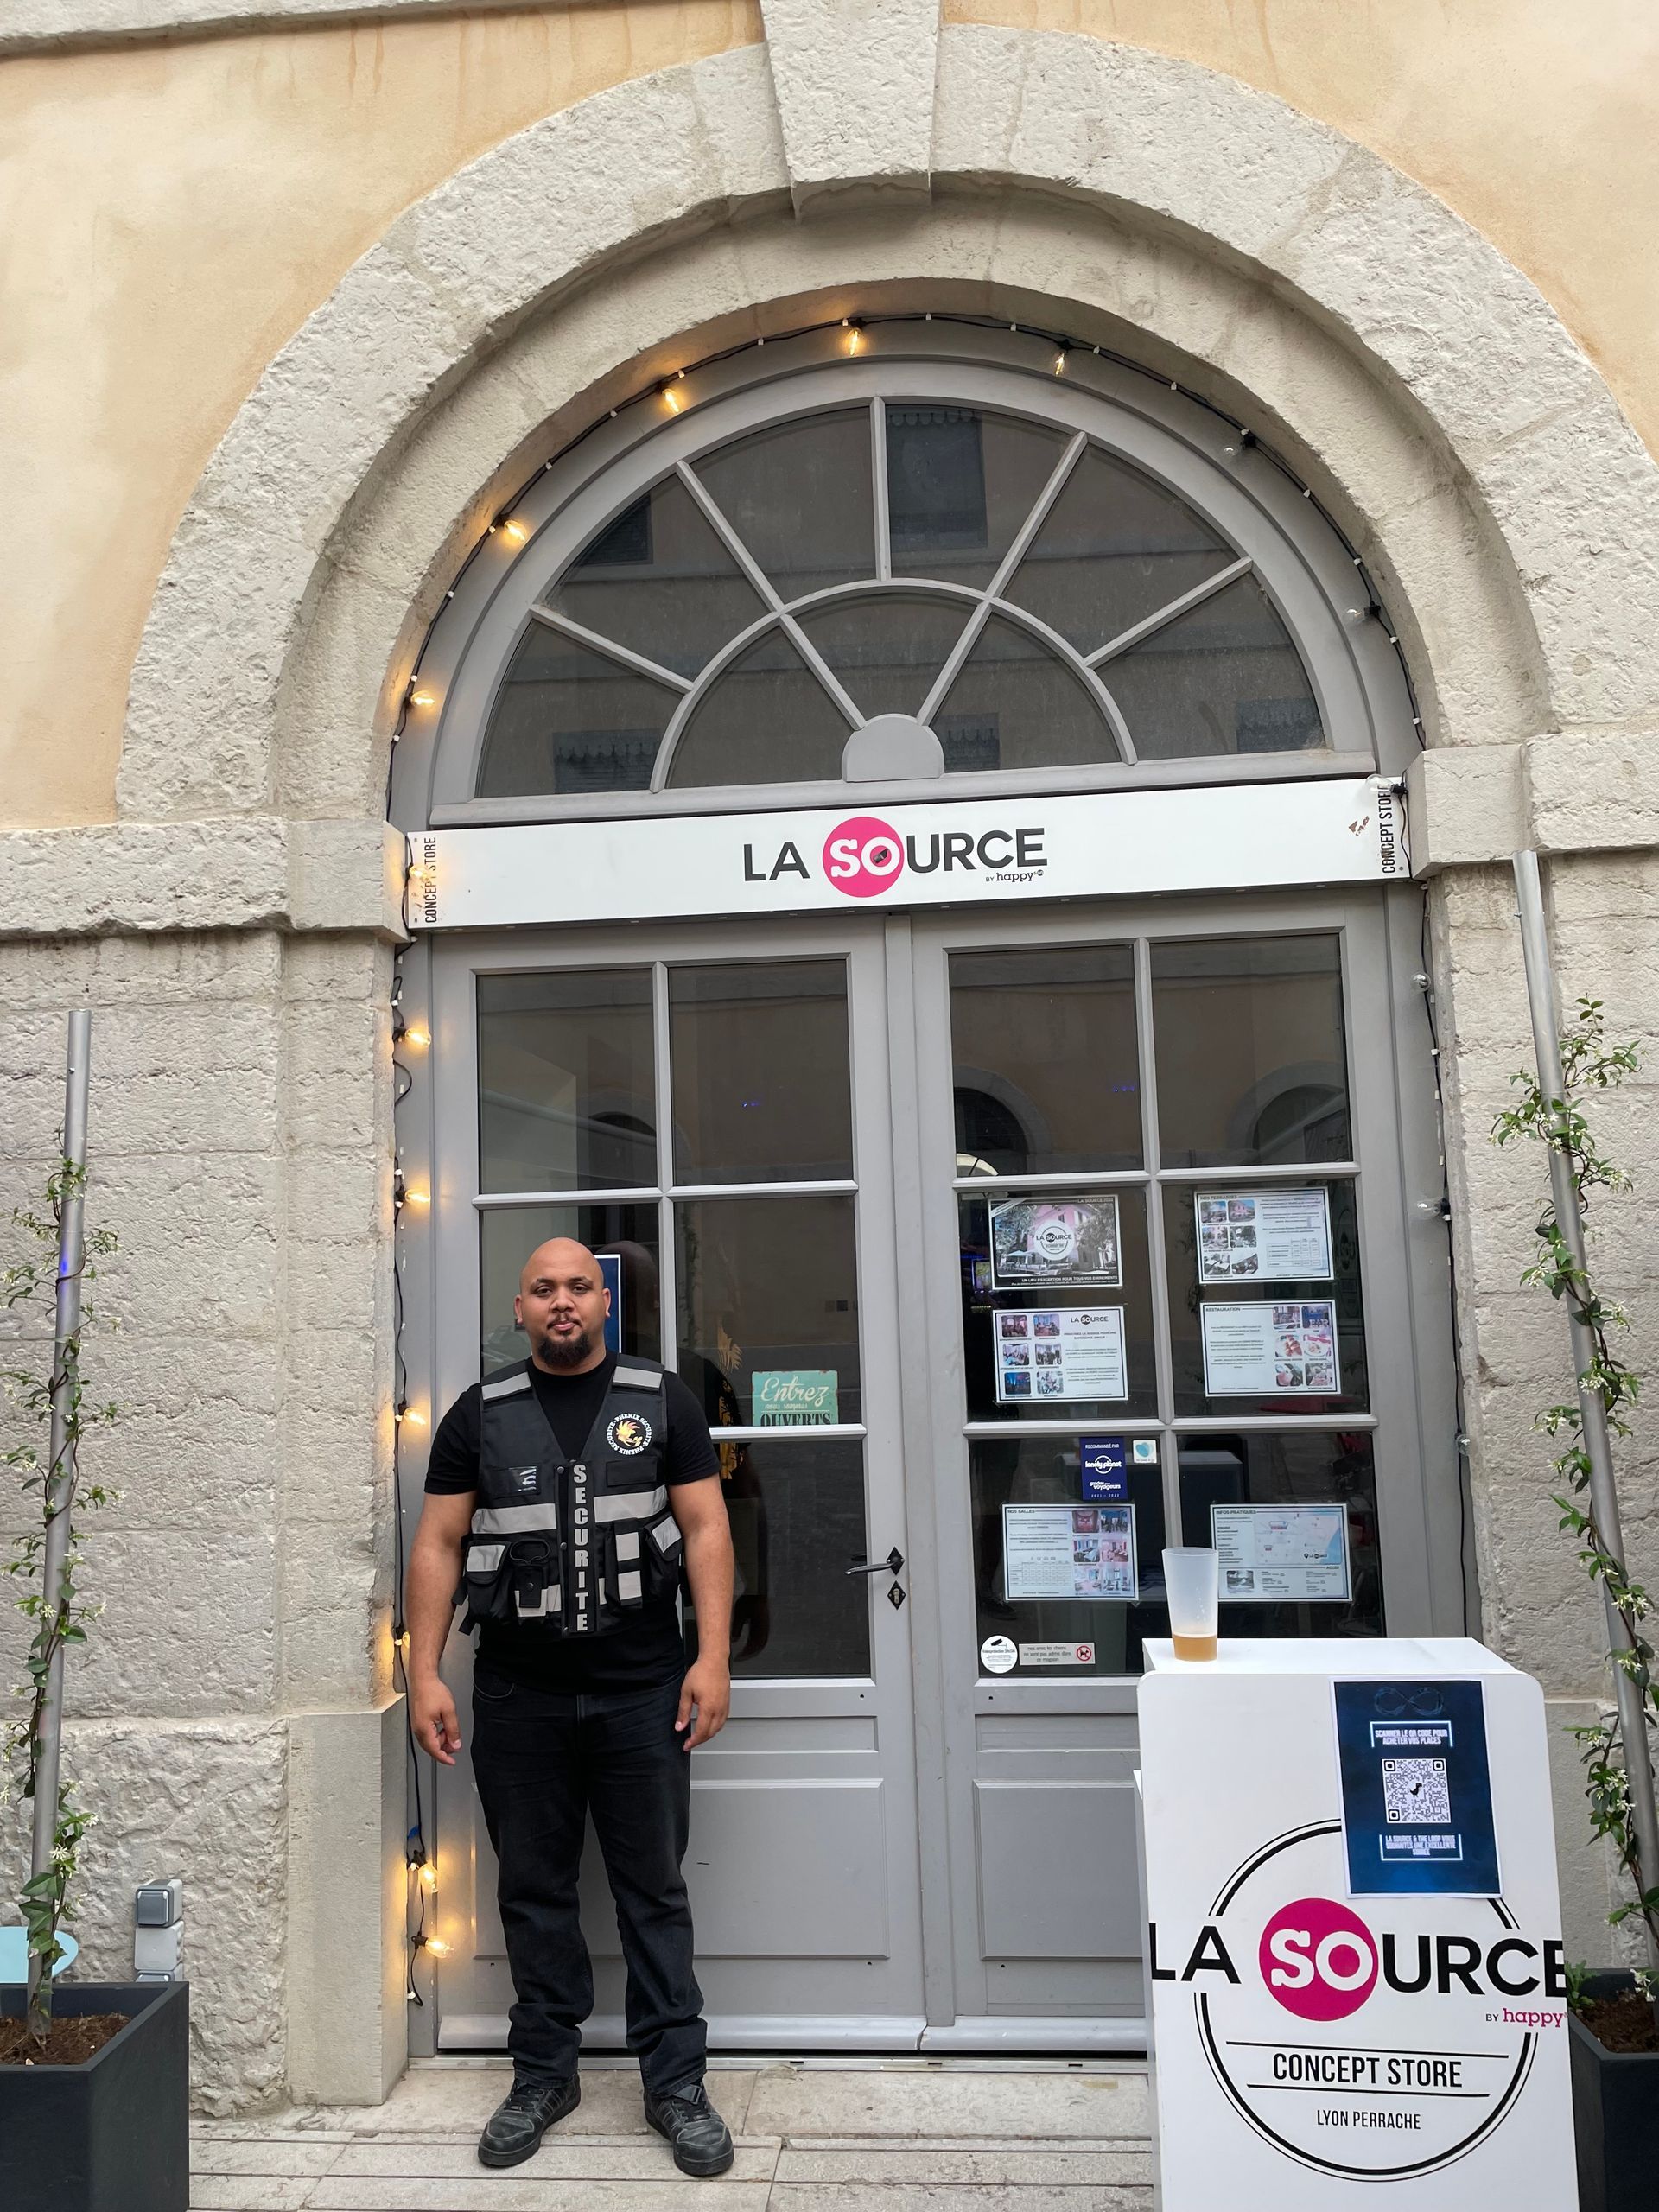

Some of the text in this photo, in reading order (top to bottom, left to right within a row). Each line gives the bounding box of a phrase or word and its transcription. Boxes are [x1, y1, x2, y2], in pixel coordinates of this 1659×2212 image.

[743, 827, 1048, 881] LA SOURCE
[1380, 823, 1396, 874] CONCEPT
[761, 1376, 830, 1407] Entrez
[1084, 1460, 1122, 1469] lonely planet
[572, 1464, 588, 1631] SECURITE
[1401, 1729, 1408, 1738] LE
[1417, 1729, 1433, 1738] CODE
[1148, 1923, 1242, 1985] LA
[1485, 2007, 1564, 2028] BY happy
[1273, 2053, 1463, 2088] CONCEPT STORE
[1317, 2109, 1421, 2130] LYON PERRACHE
